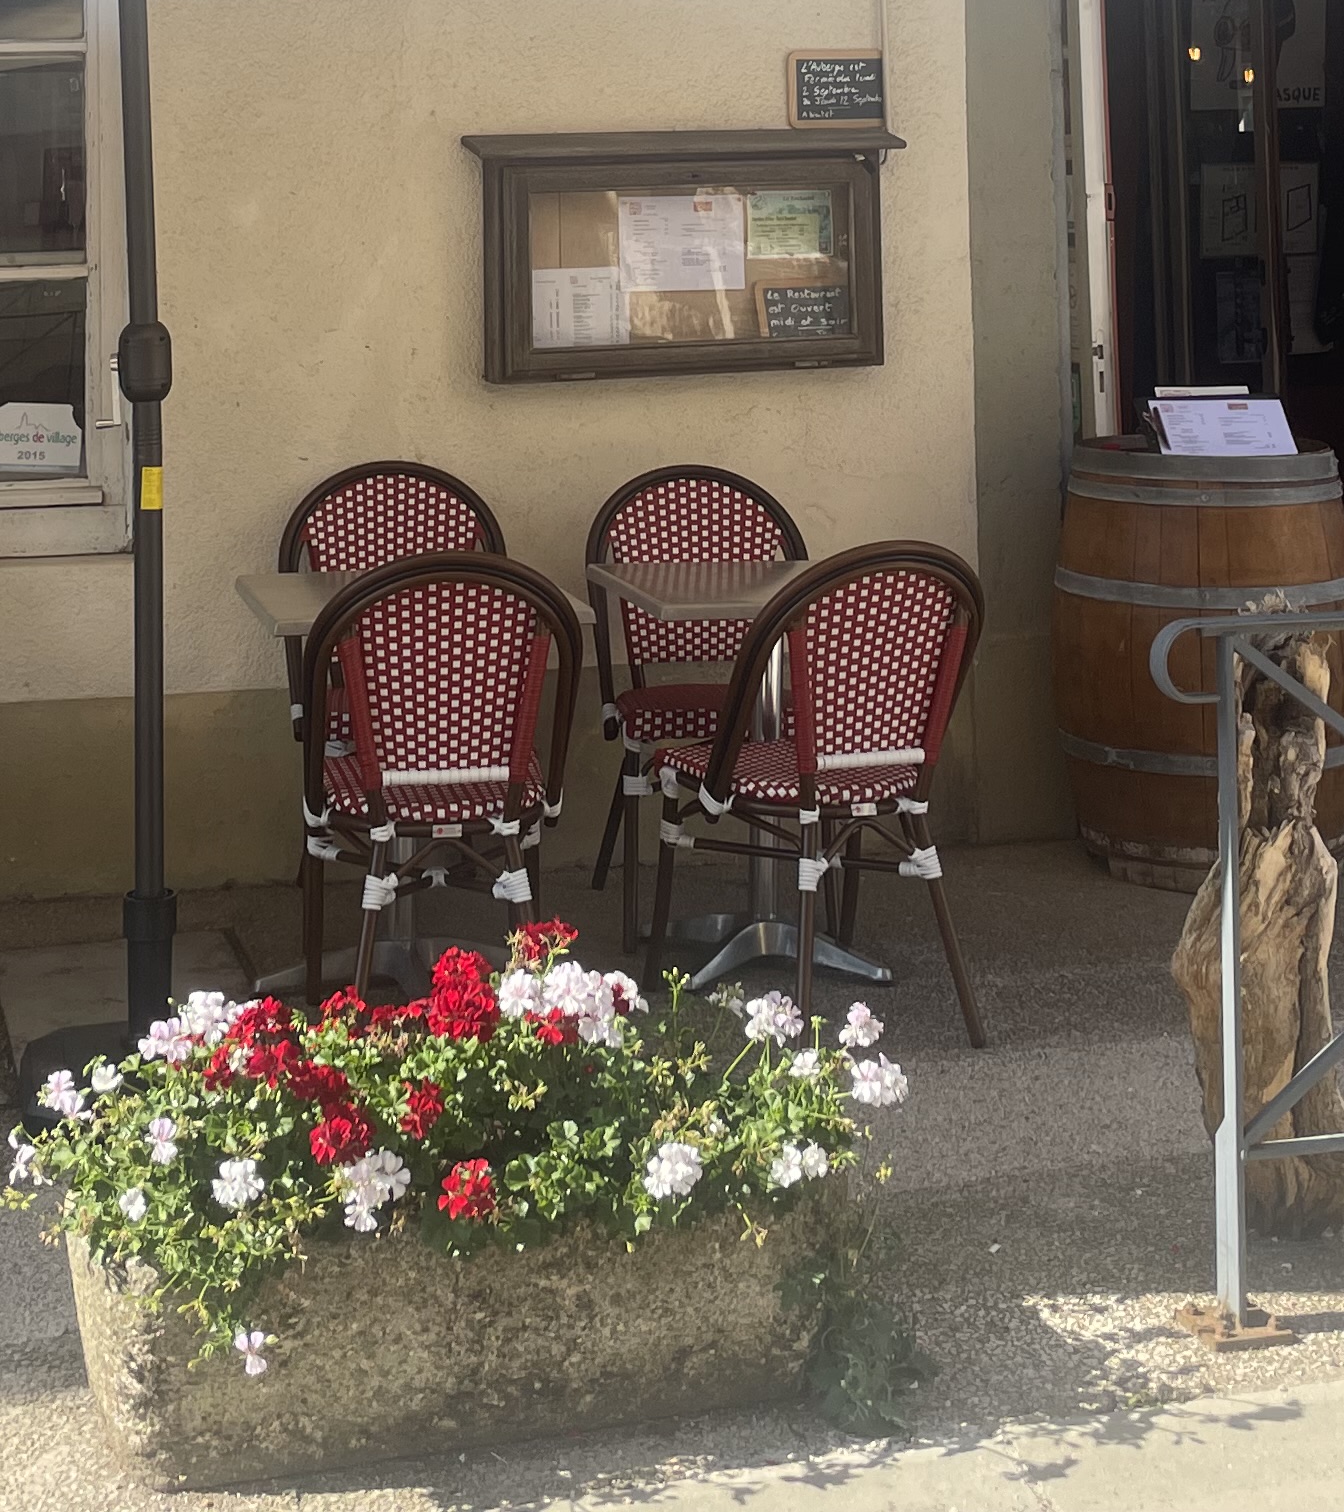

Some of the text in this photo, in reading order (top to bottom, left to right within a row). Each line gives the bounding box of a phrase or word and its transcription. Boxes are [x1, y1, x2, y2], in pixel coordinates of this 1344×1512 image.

[803, 87, 809, 95] 2
[1276, 87, 1321, 103] ASQUE
[839, 96, 849, 105] 12
[32, 431, 44, 443] de
[47, 431, 78, 447] village
[17, 451, 45, 460] 2015
